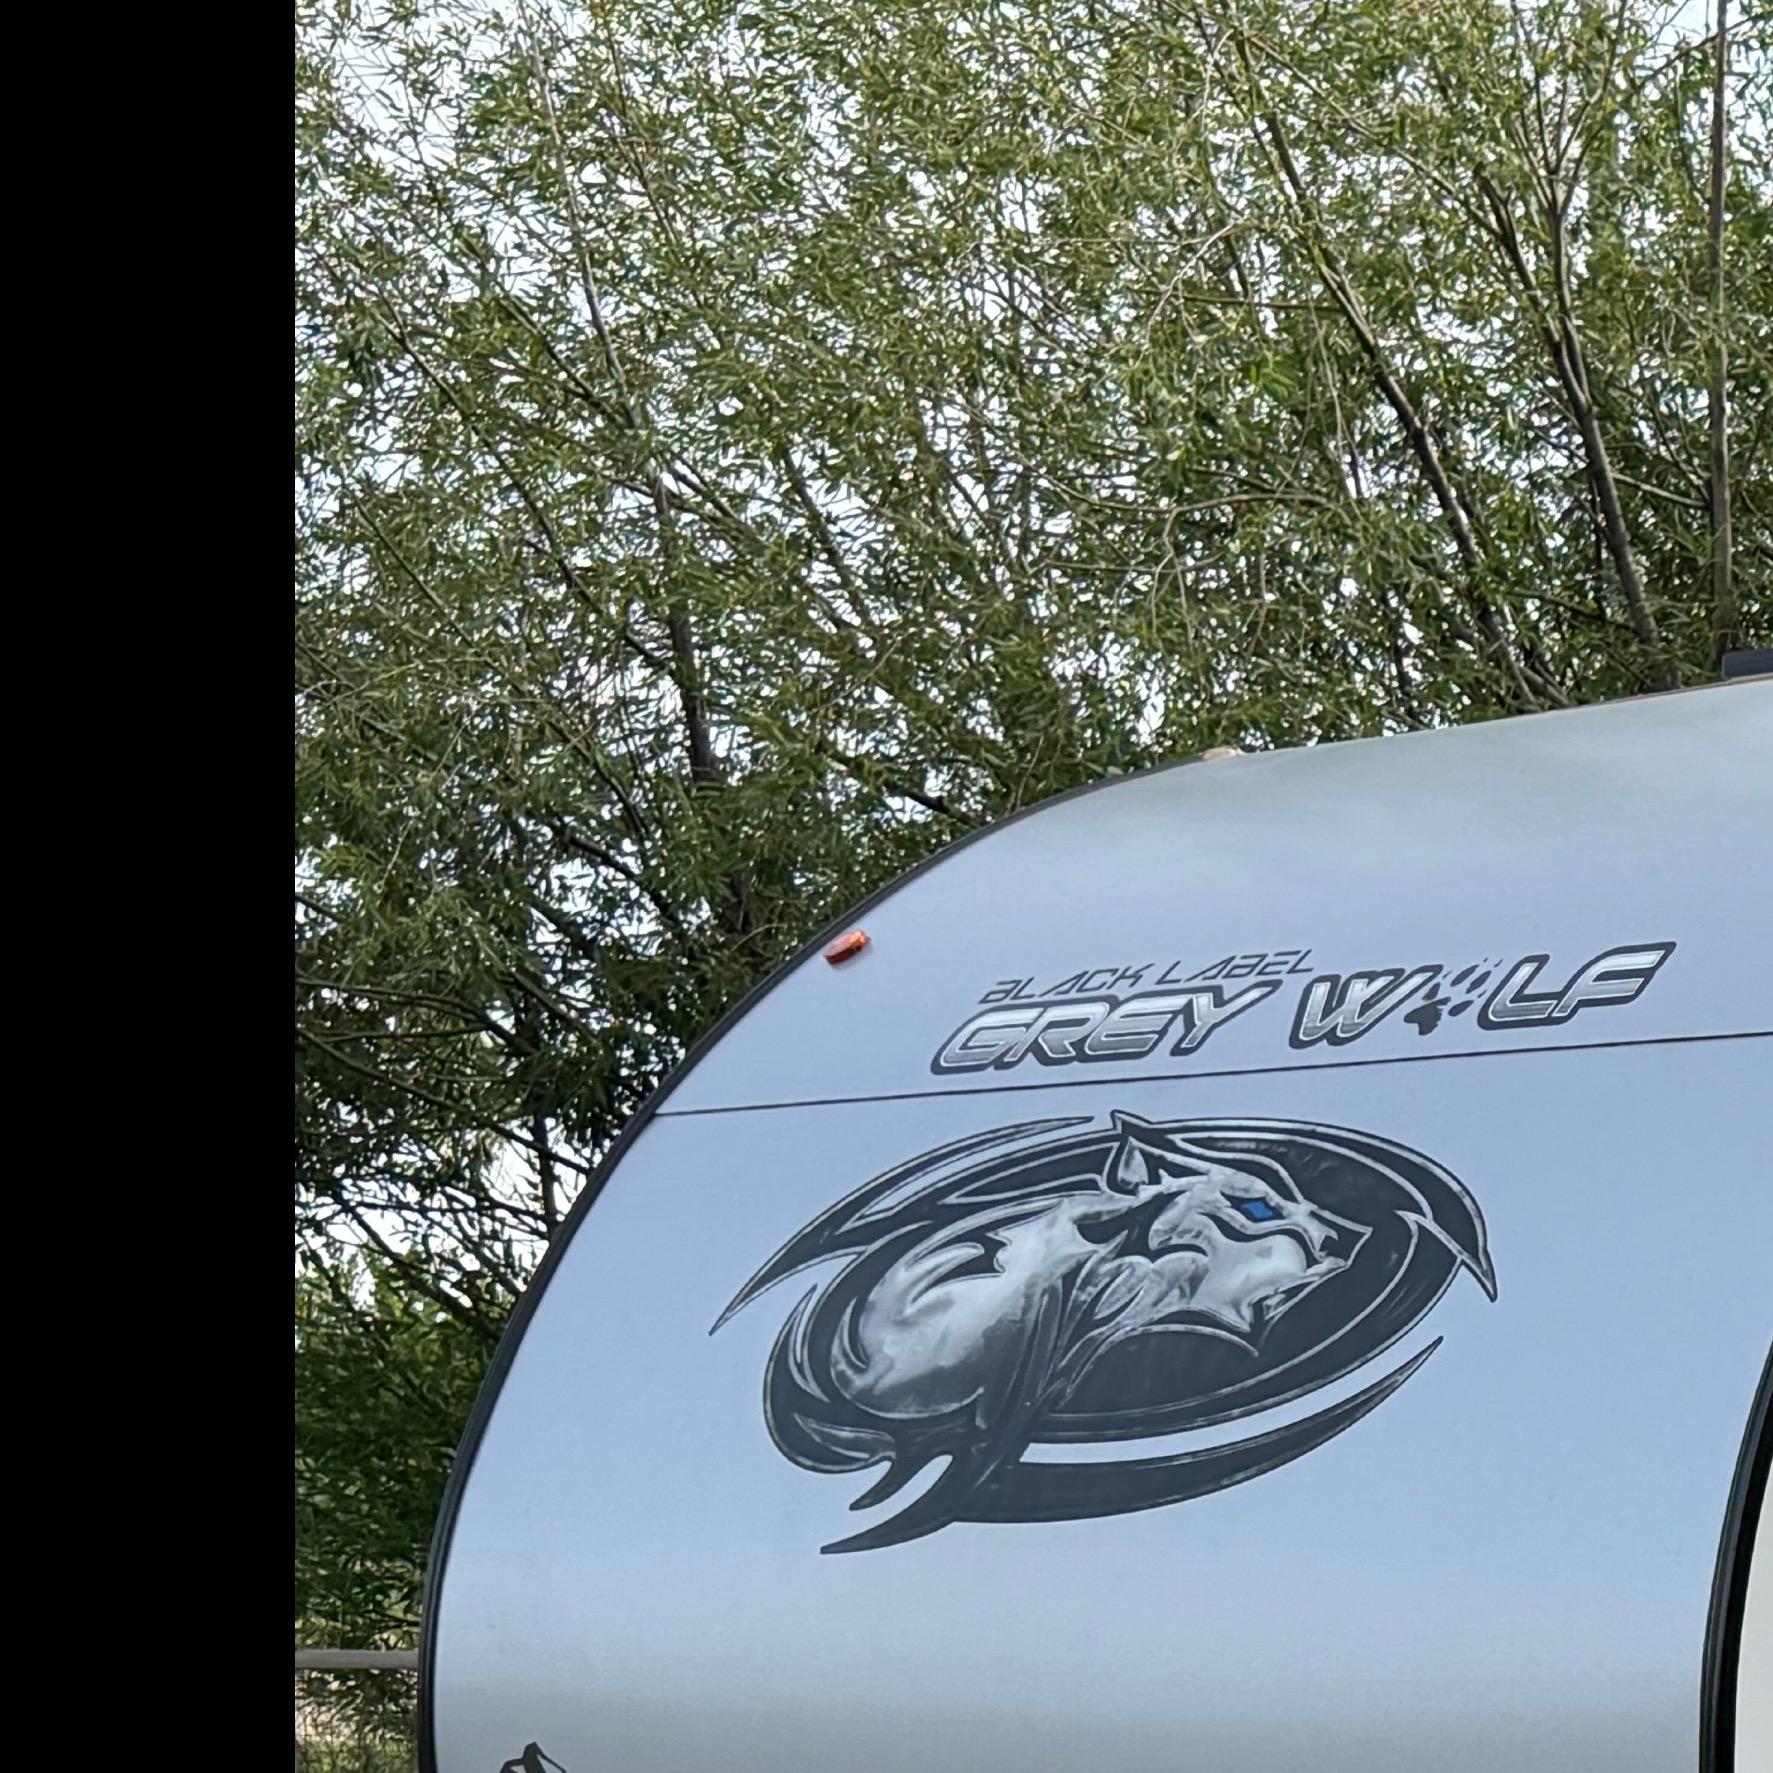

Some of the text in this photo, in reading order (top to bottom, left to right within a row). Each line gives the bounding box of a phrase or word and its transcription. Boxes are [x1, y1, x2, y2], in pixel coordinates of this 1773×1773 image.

[930, 941, 1677, 1076] GREY WLF
[980, 948, 1314, 1004] BLACK LABEL
